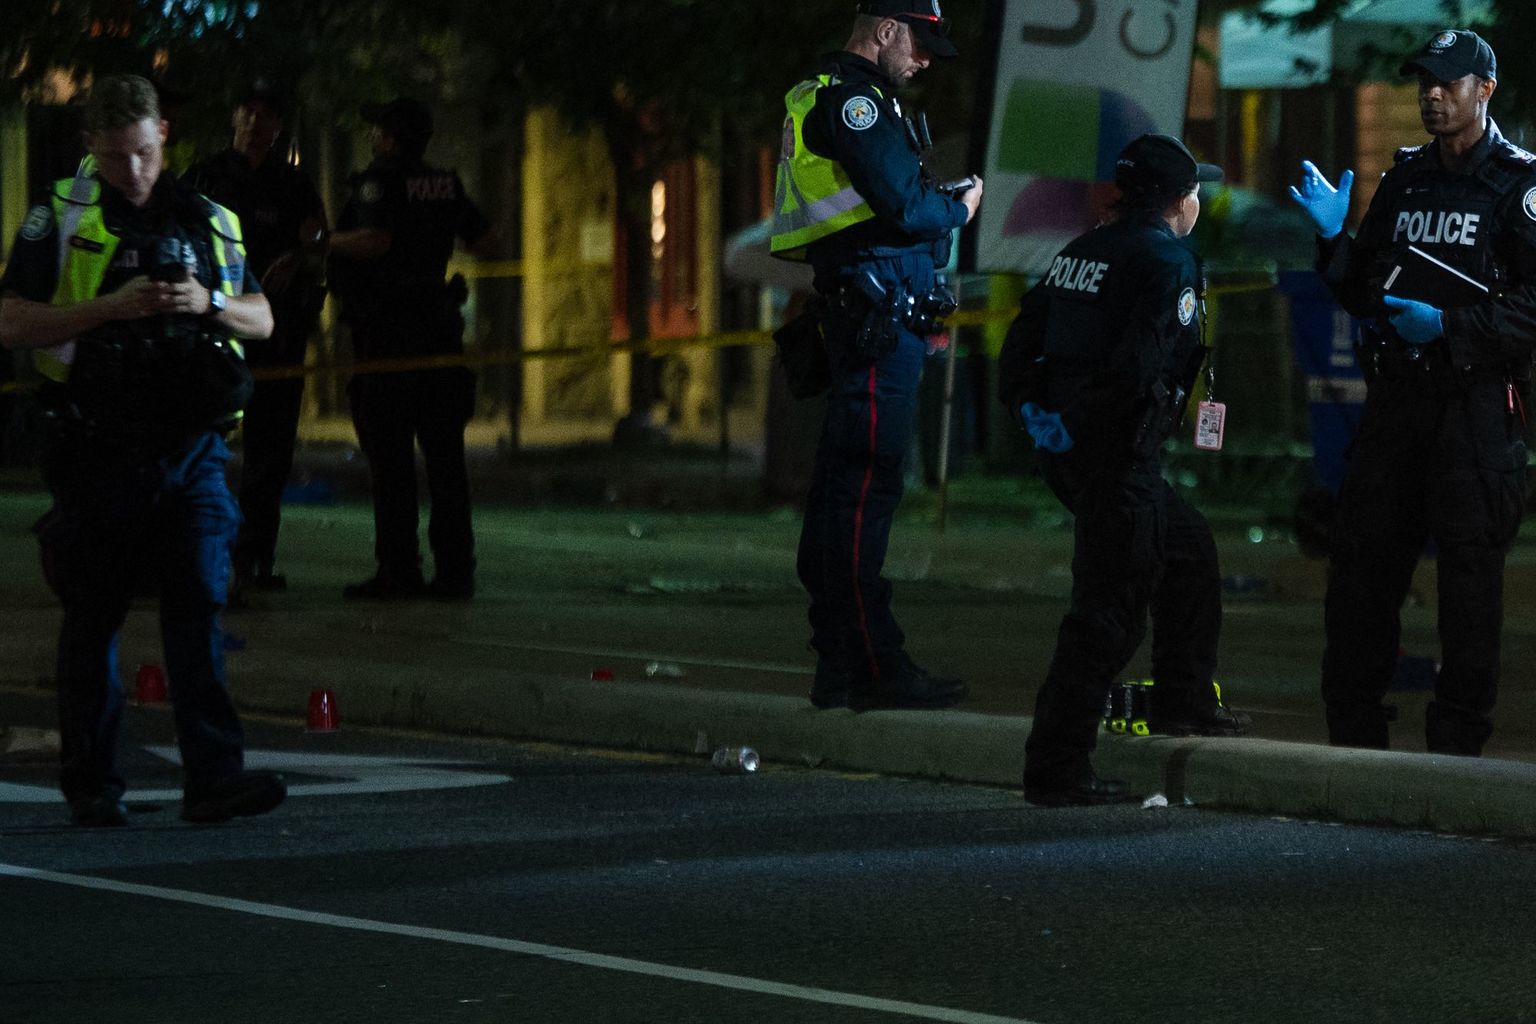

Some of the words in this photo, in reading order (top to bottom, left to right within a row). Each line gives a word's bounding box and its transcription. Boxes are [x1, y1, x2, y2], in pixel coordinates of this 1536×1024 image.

[404, 175, 456, 204] POLICE
[1392, 211, 1481, 246] POLICE
[1045, 255, 1111, 294] POLICE
